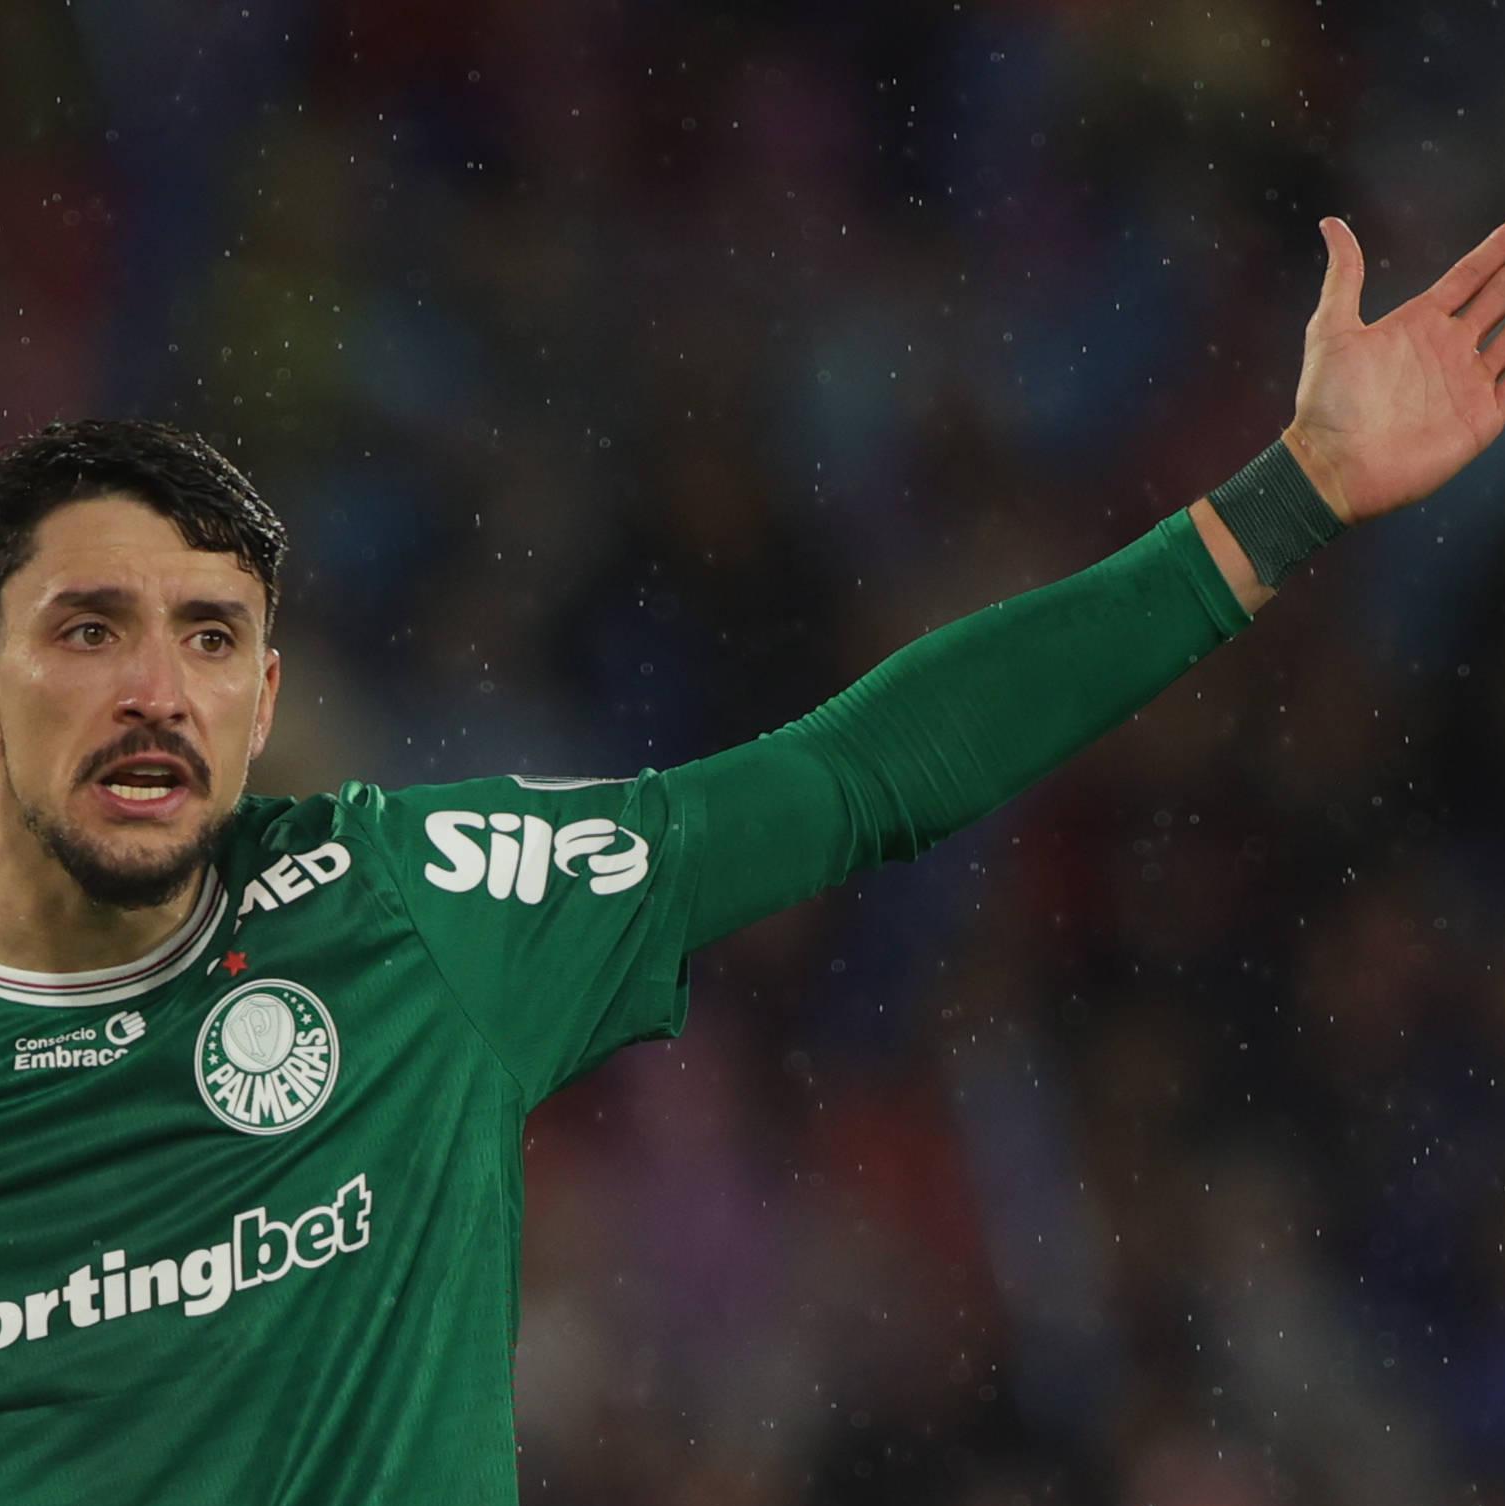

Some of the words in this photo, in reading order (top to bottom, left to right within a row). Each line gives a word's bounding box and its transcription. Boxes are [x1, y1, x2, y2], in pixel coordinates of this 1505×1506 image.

[233, 841, 352, 935] MED
[13, 1045, 129, 1071] Embrac
[205, 1026, 330, 1125] PALMEIRAS
